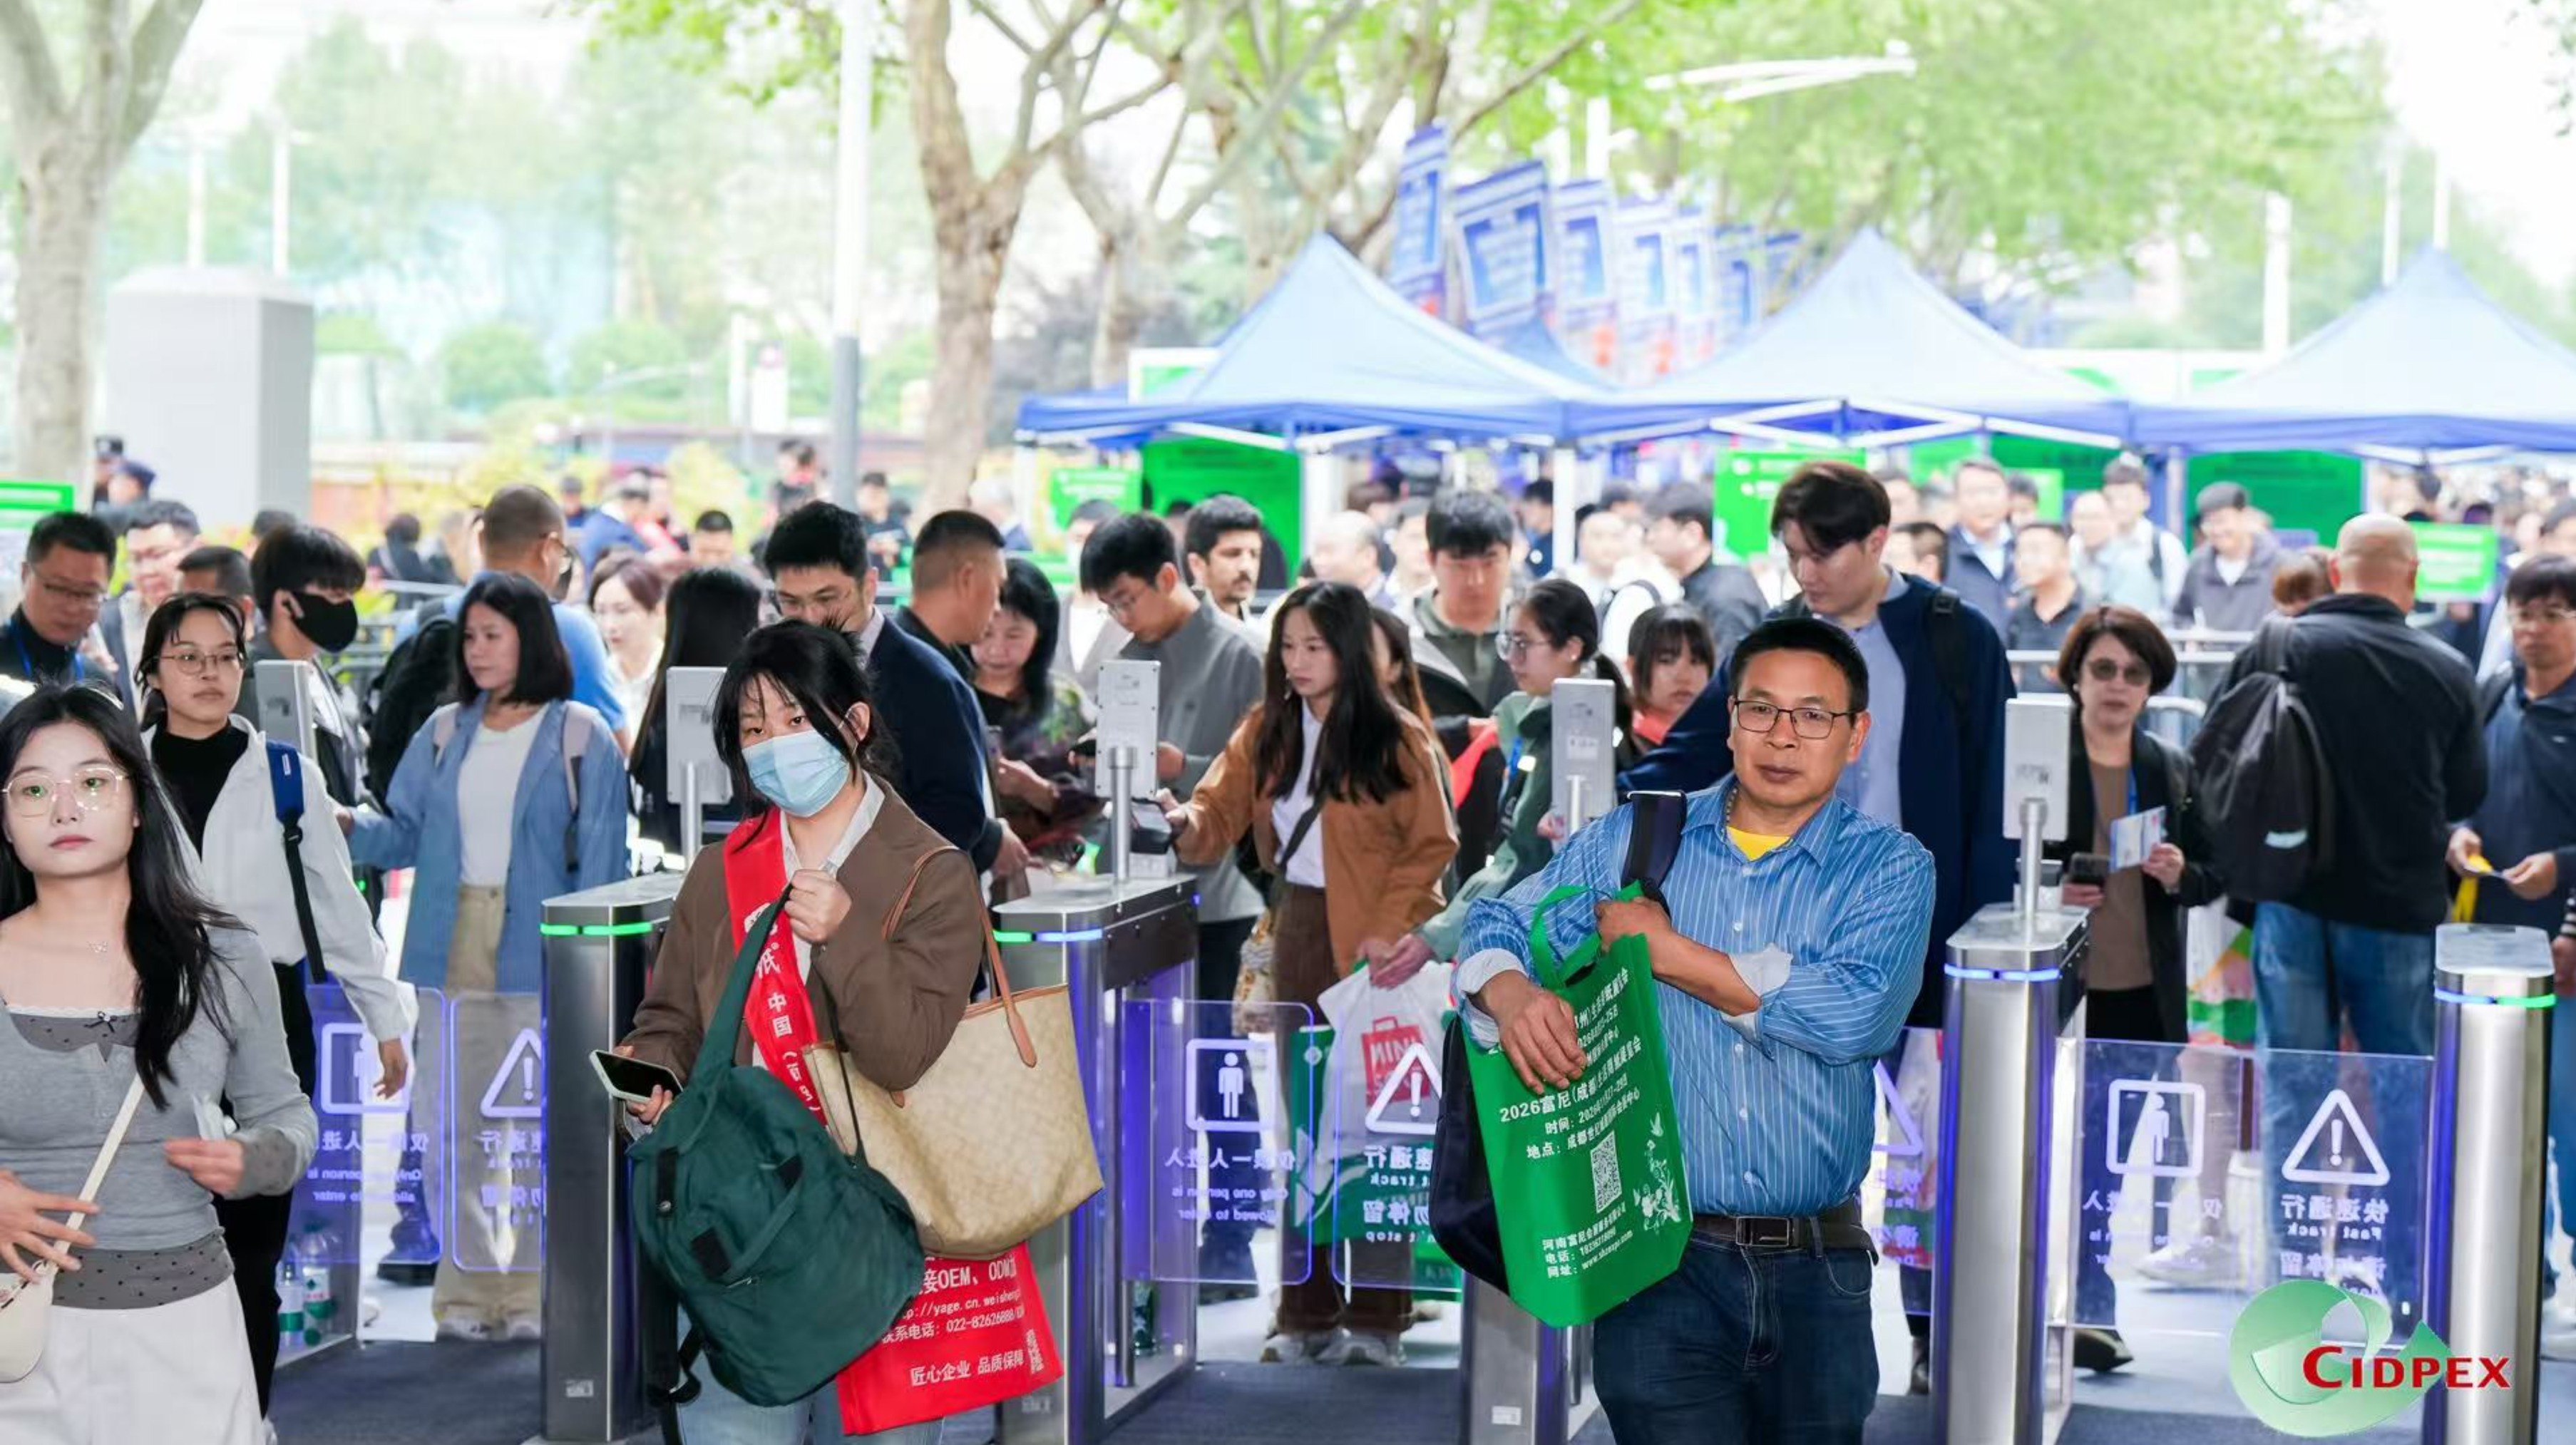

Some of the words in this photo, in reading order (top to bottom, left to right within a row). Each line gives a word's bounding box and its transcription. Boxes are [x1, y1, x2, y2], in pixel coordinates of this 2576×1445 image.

[910, 1359, 972, 1387] 匠心企业
[977, 1349, 1024, 1375] 品质保障
